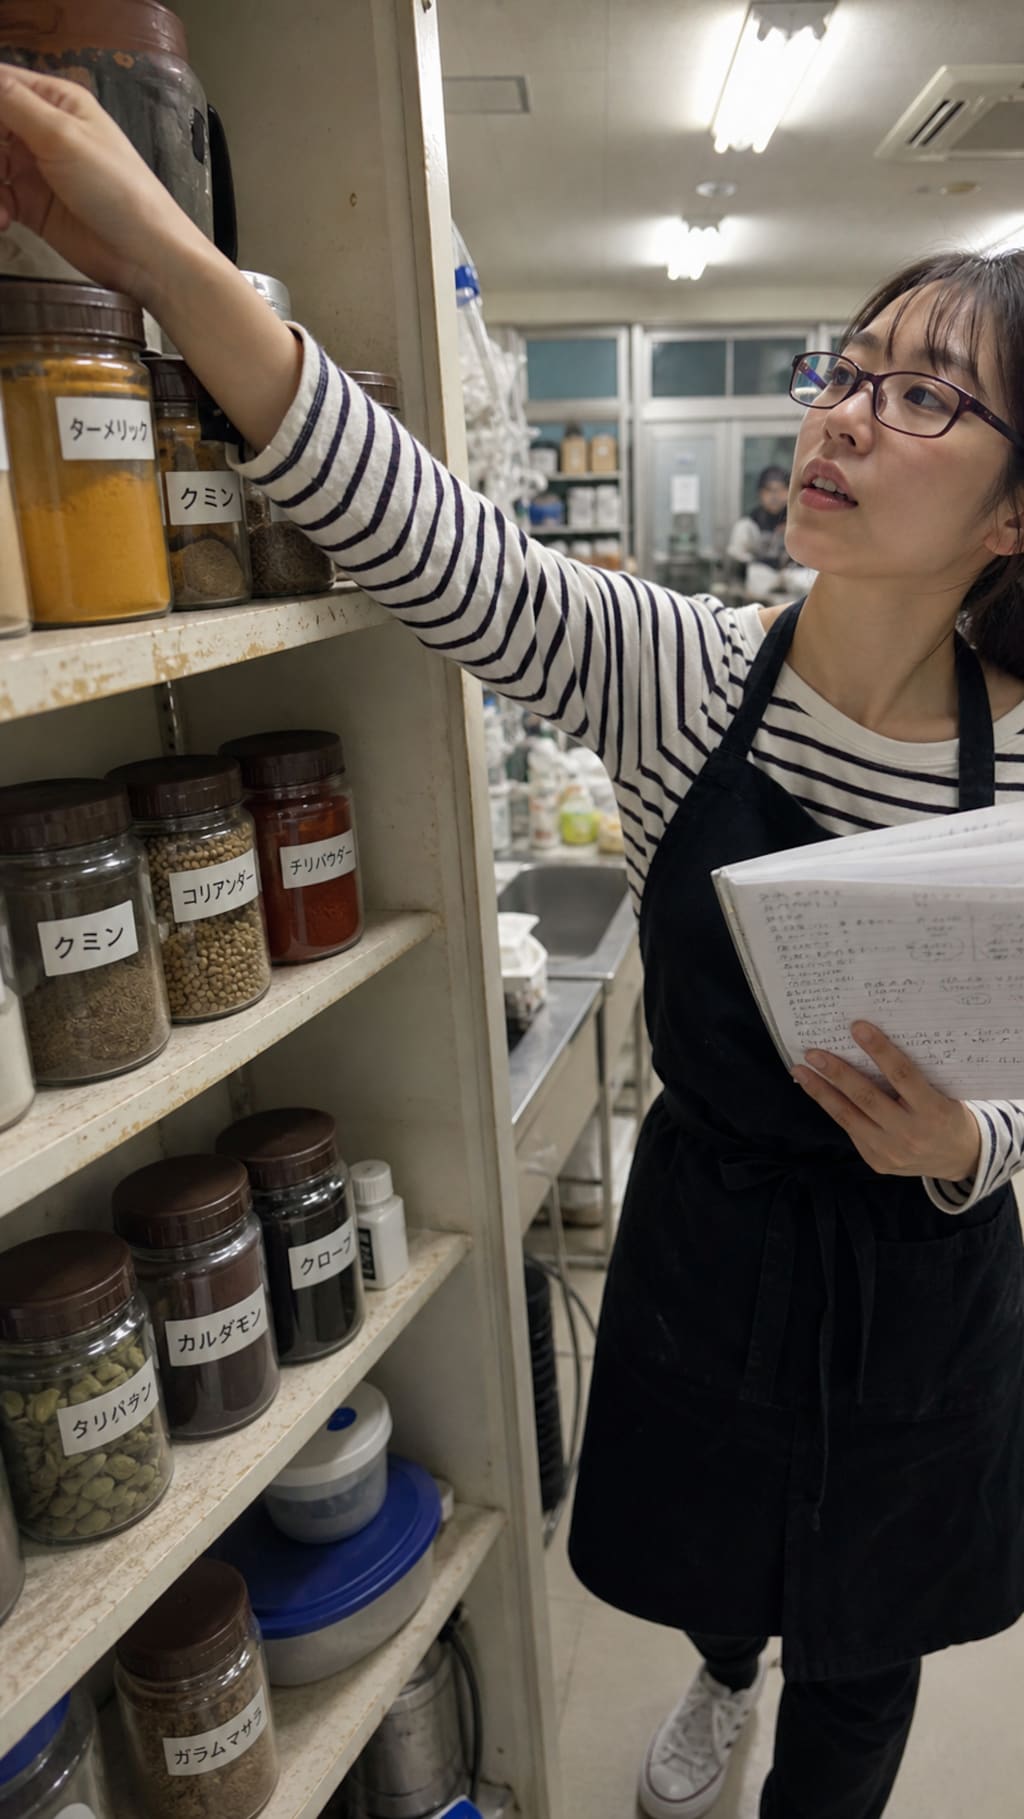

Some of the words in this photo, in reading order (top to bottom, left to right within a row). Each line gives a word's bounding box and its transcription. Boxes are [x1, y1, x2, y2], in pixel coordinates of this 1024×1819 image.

[70, 418, 148, 441] ターメリック
[181, 488, 233, 510] クミン
[183, 869, 254, 905] コリアンダー
[55, 927, 123, 959] クミン
[178, 1308, 261, 1352] カルダモン
[174, 1707, 262, 1765] ガラムマサラ
